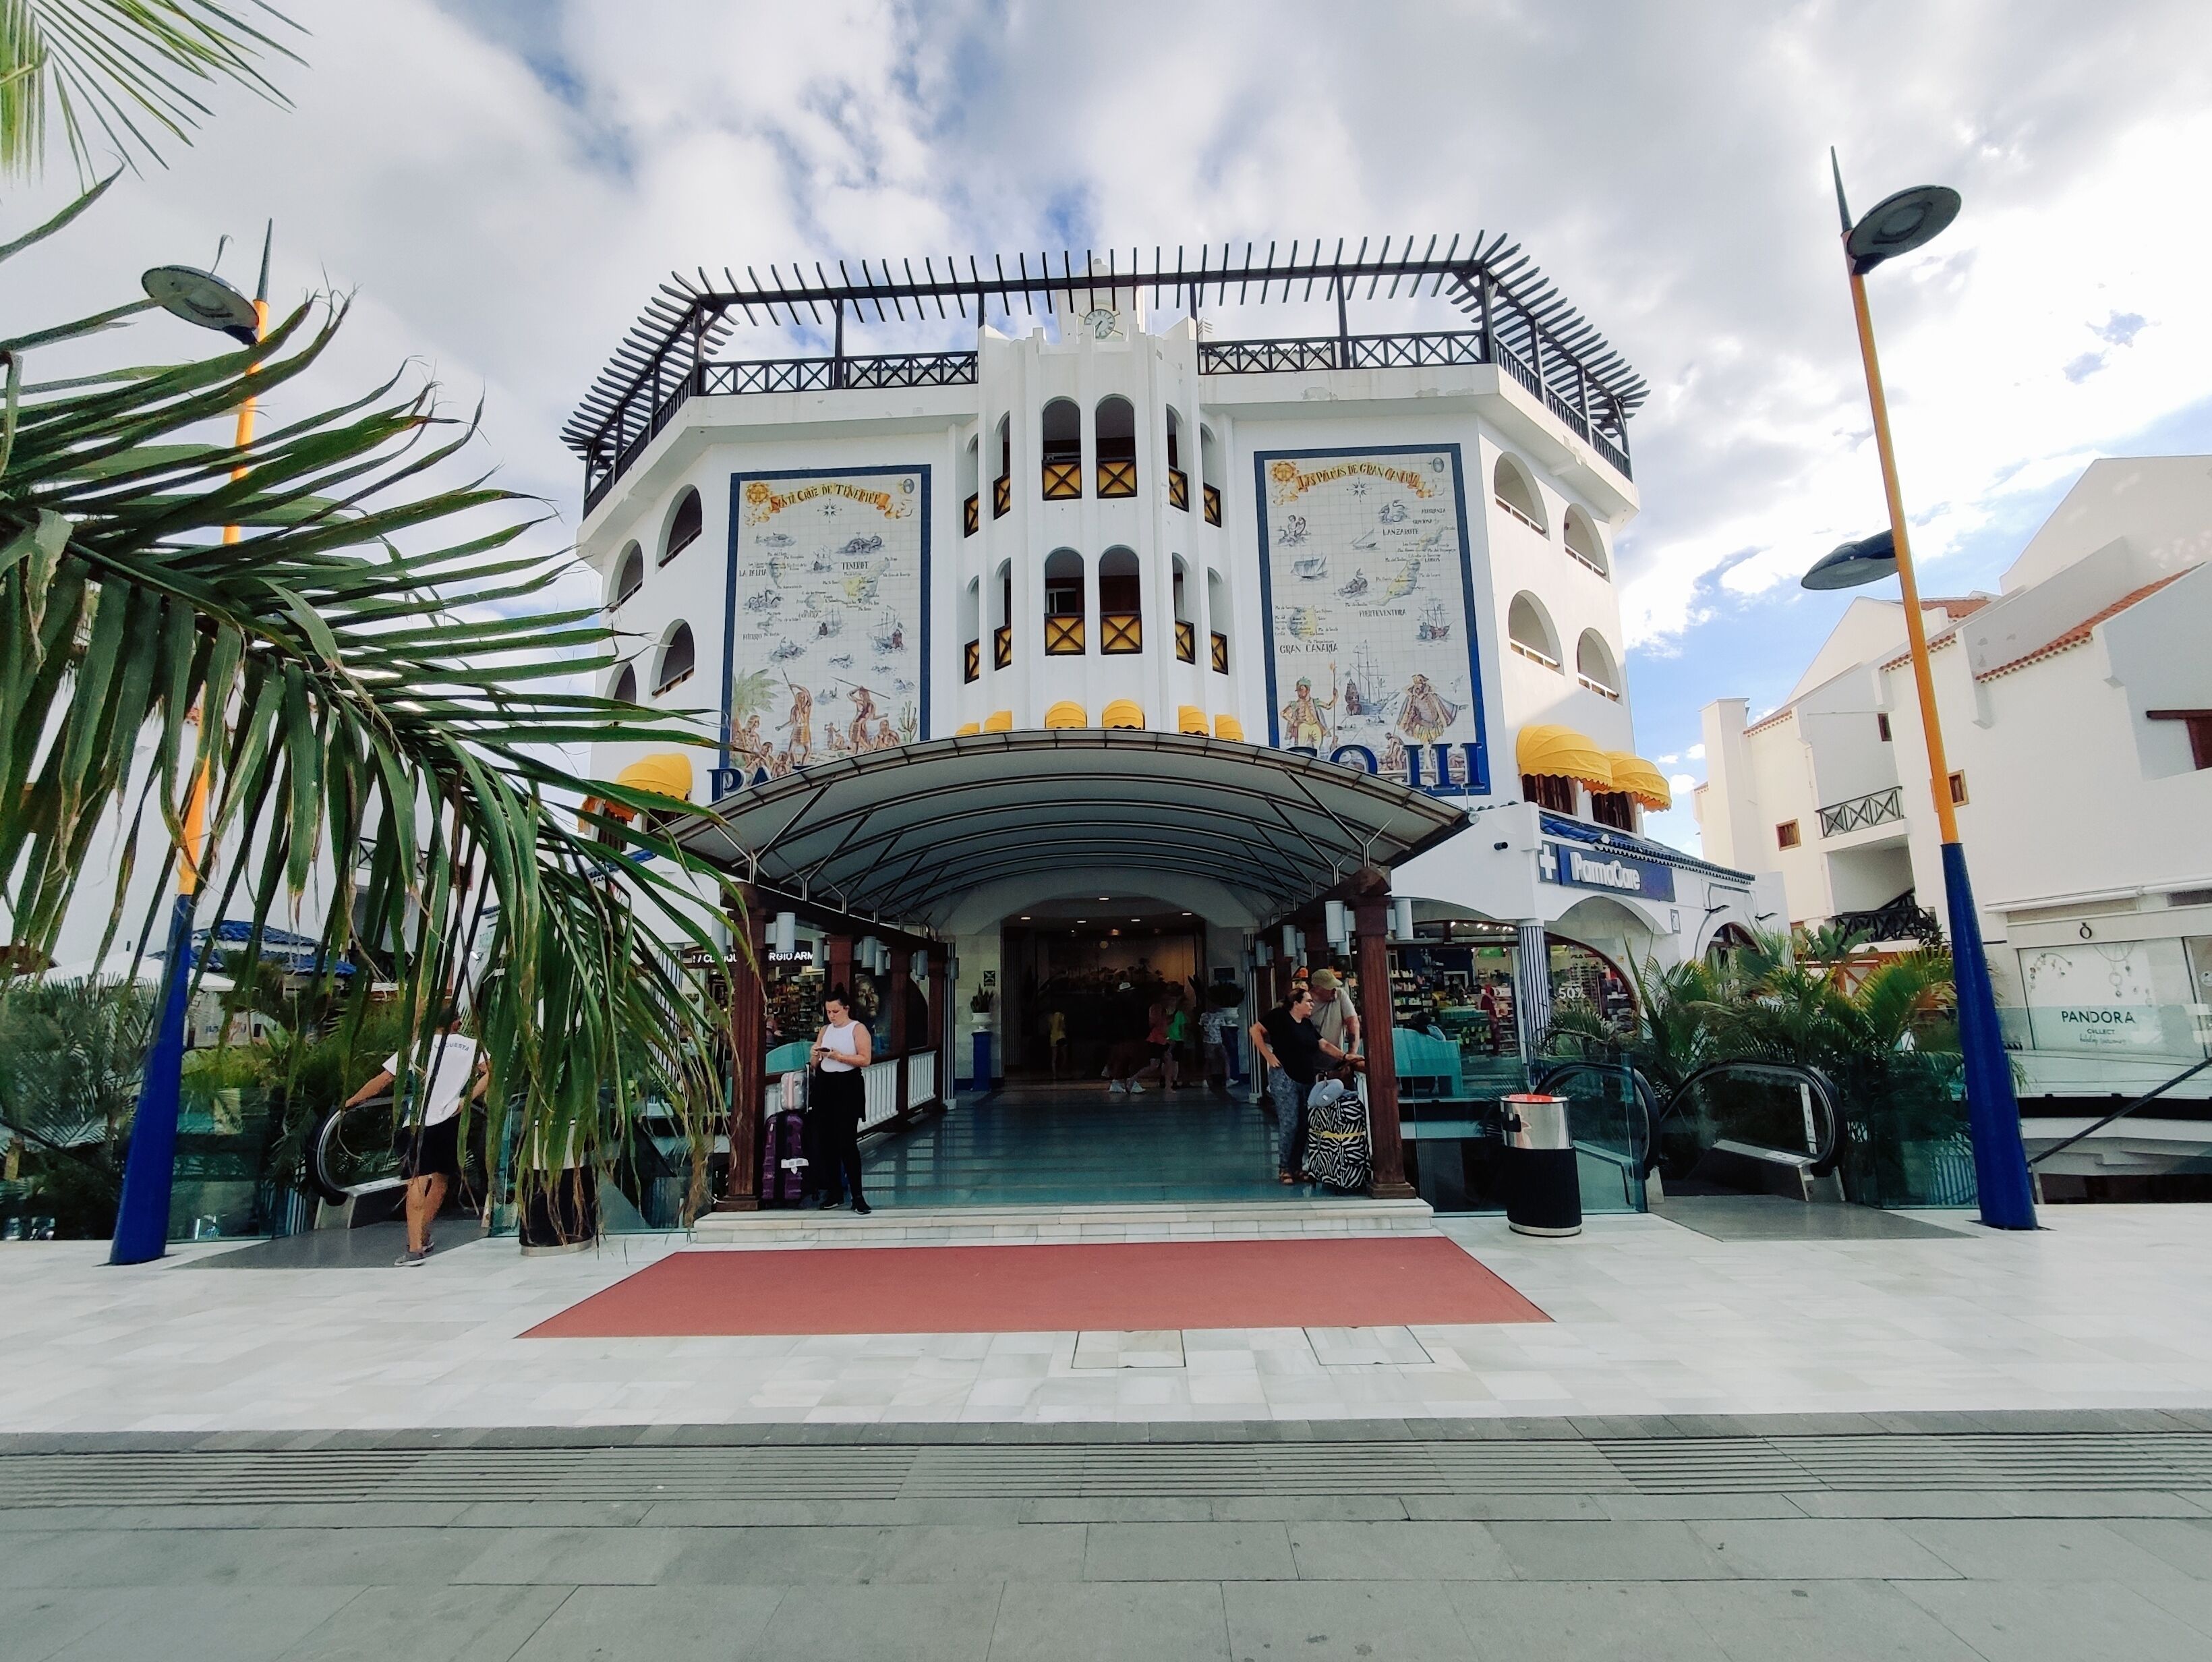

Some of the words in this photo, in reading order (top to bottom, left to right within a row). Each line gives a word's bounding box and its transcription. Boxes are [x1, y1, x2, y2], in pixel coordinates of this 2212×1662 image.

[1347, 464, 1358, 474] DE
[1360, 463, 1382, 477] GRAN
[822, 485, 832, 495] DE
[1360, 609, 1407, 617] FUERTEVENTURA
[1279, 644, 1301, 654] GRAN
[1306, 643, 1338, 654] CANARIA
[1402, 743, 1485, 789] III
[2061, 1010, 2136, 1024] PANDORA
